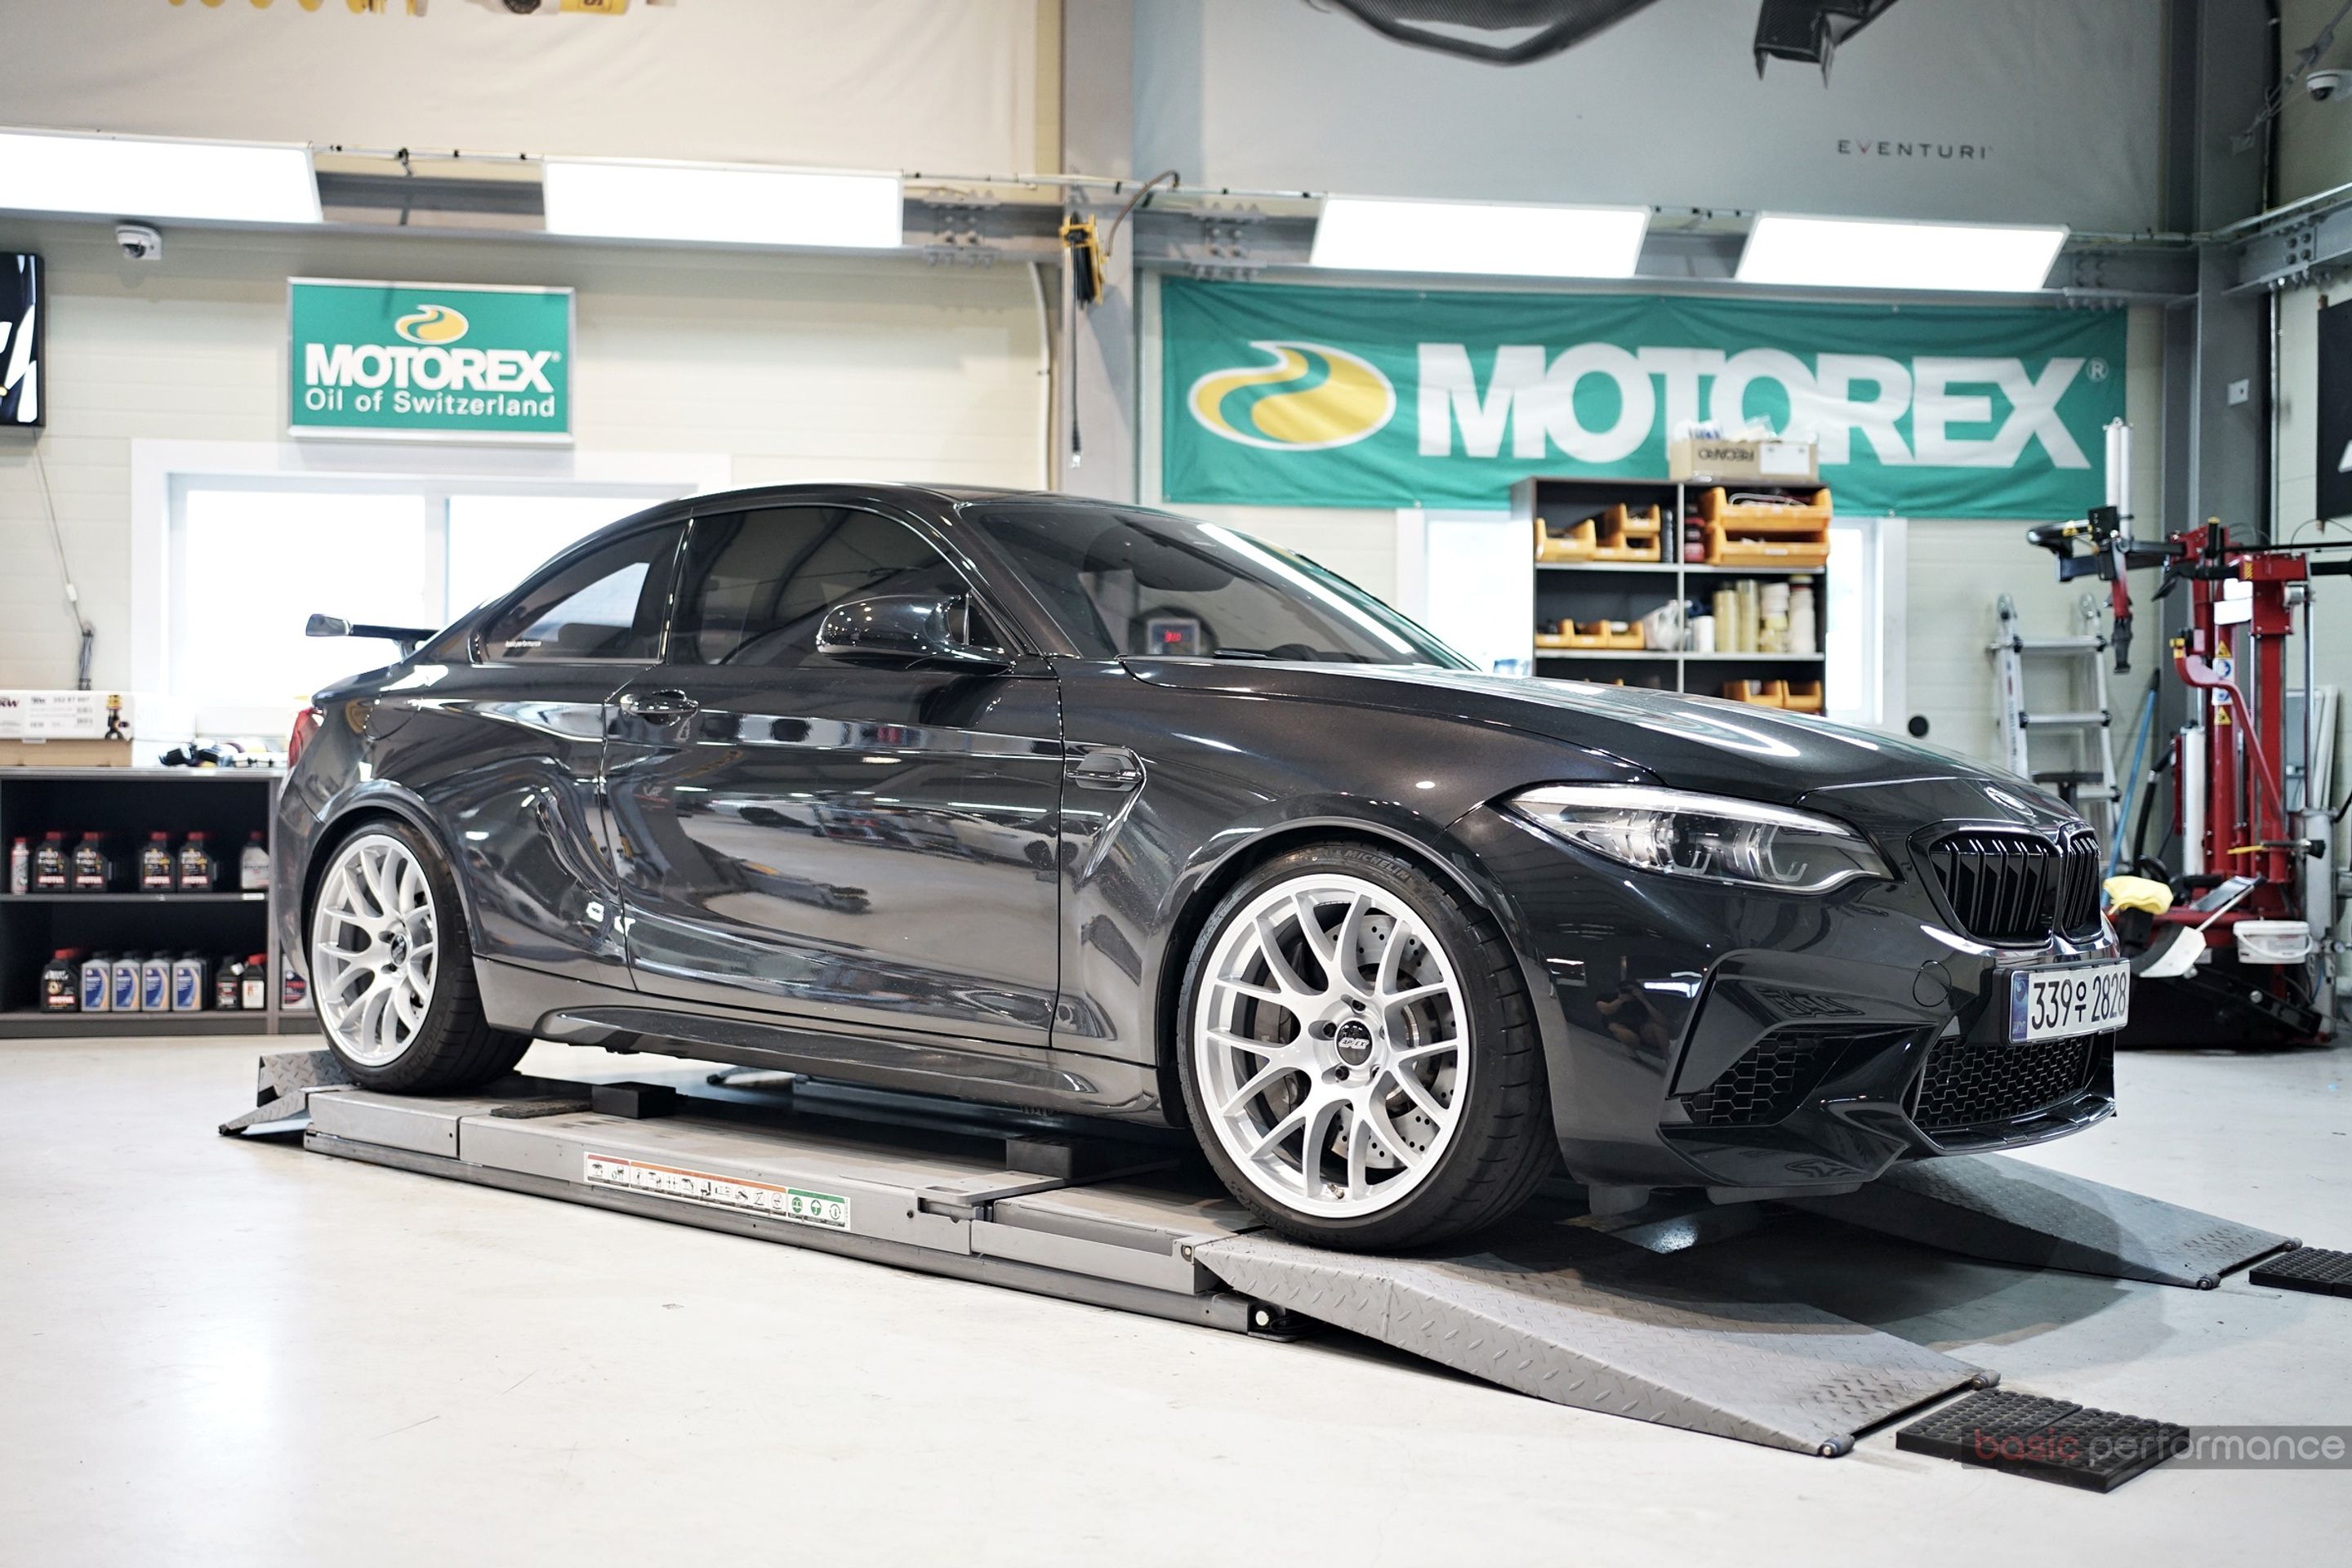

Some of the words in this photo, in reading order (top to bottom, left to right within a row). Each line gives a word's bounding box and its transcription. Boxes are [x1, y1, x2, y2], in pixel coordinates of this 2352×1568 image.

[1837, 139, 1986, 160] EVENTURI
[305, 391, 344, 412] Oil
[355, 390, 382, 412] of
[393, 390, 555, 418] Switzerland
[1344, 849, 1411, 883] MICHELIN
